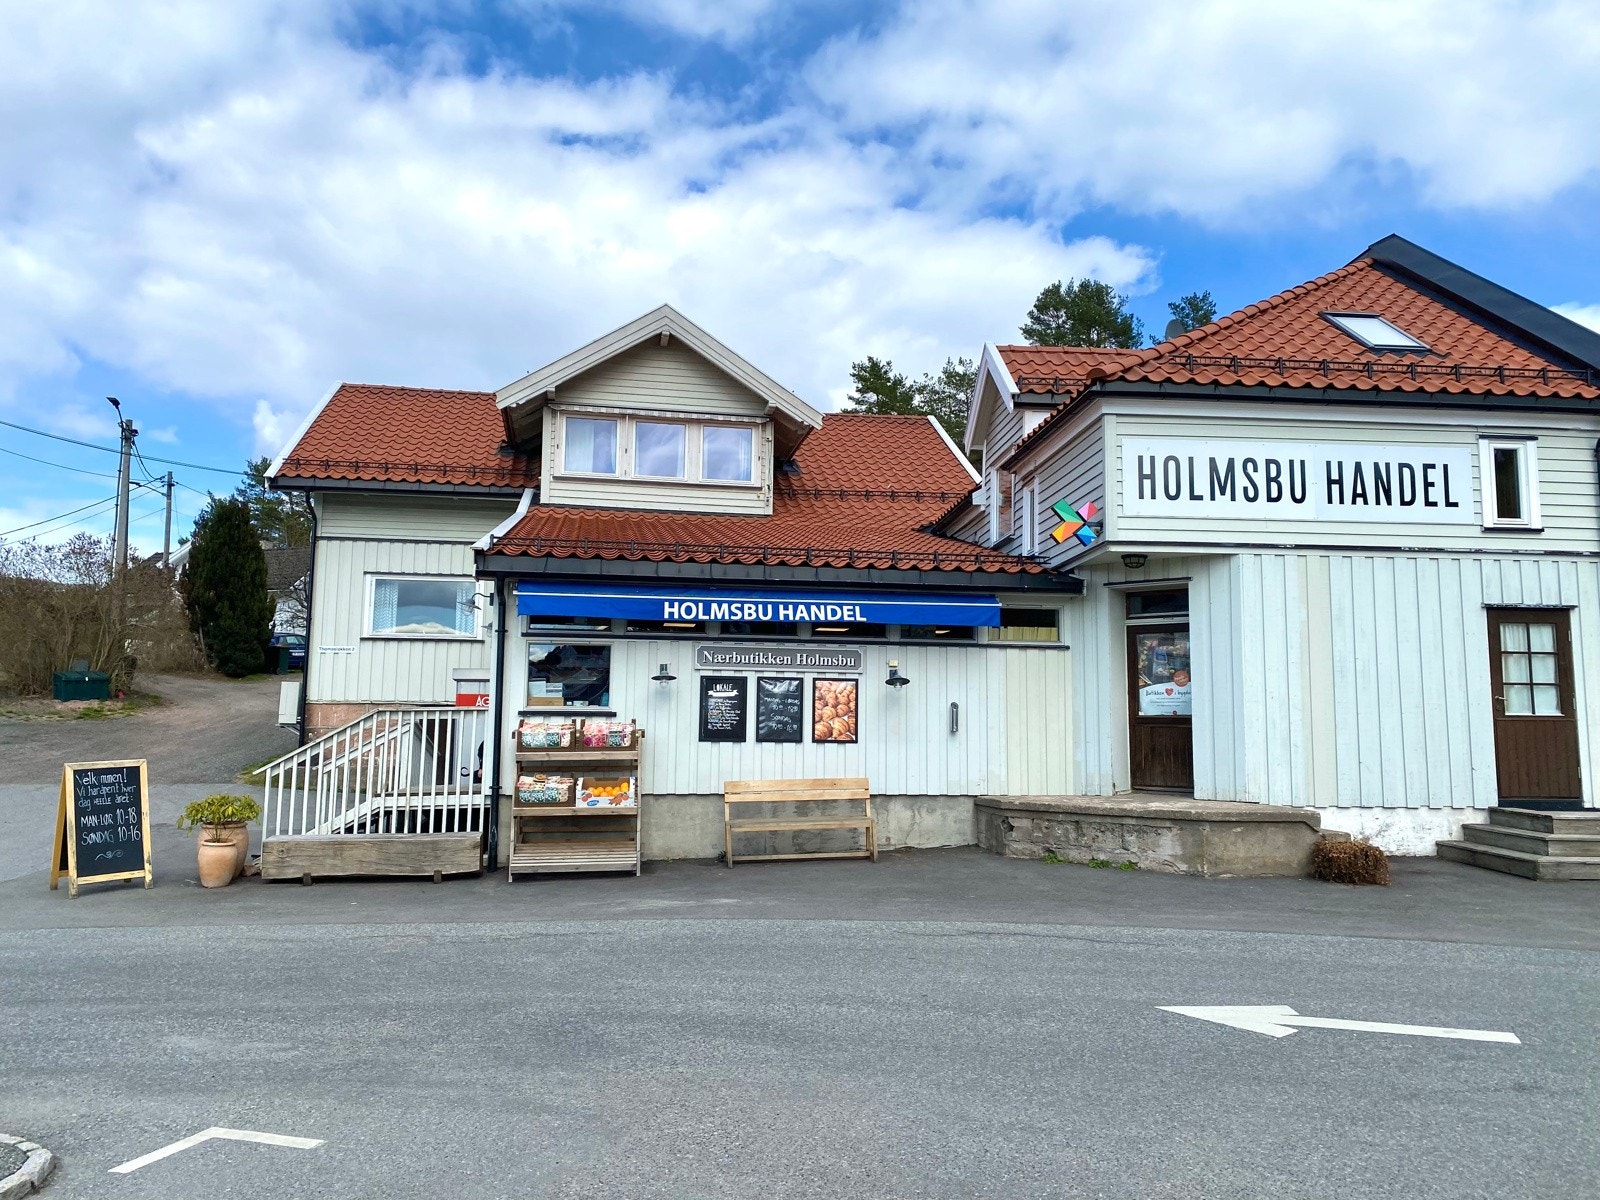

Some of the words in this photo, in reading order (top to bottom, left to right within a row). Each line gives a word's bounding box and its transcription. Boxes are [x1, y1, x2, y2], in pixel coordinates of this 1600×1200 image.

[1137, 454, 1307, 504] HOLMSBU
[1325, 460, 1459, 508] HANDEL
[663, 601, 773, 620] HOLMSBU
[778, 603, 867, 621] HANDEL
[702, 650, 792, 665] Nærbutikken
[796, 653, 856, 667] Holmsbu
[712, 683, 733, 692] LOKALE
[78, 797, 91, 811] dag
[117, 825, 141, 842] 10-16
